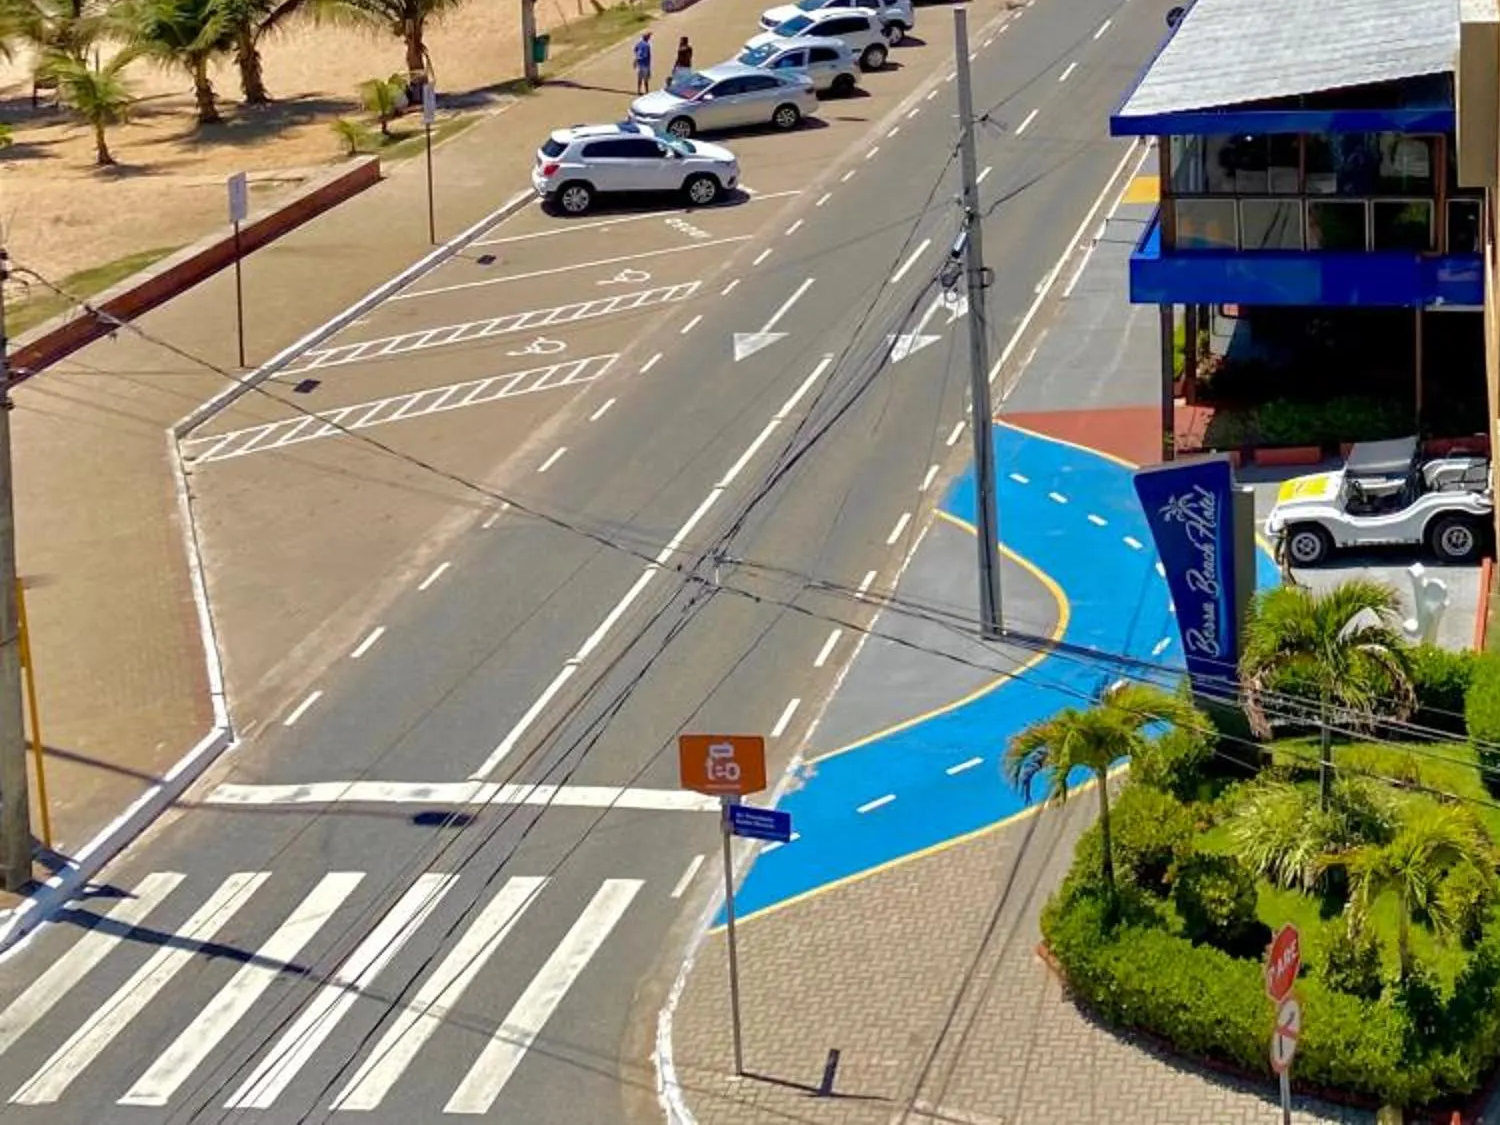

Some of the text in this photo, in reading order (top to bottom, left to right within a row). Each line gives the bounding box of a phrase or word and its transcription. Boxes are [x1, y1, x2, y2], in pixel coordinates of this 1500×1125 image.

[1185, 484, 1221, 658] Bessa Beach Hotel
[1268, 938, 1298, 984] PARE
